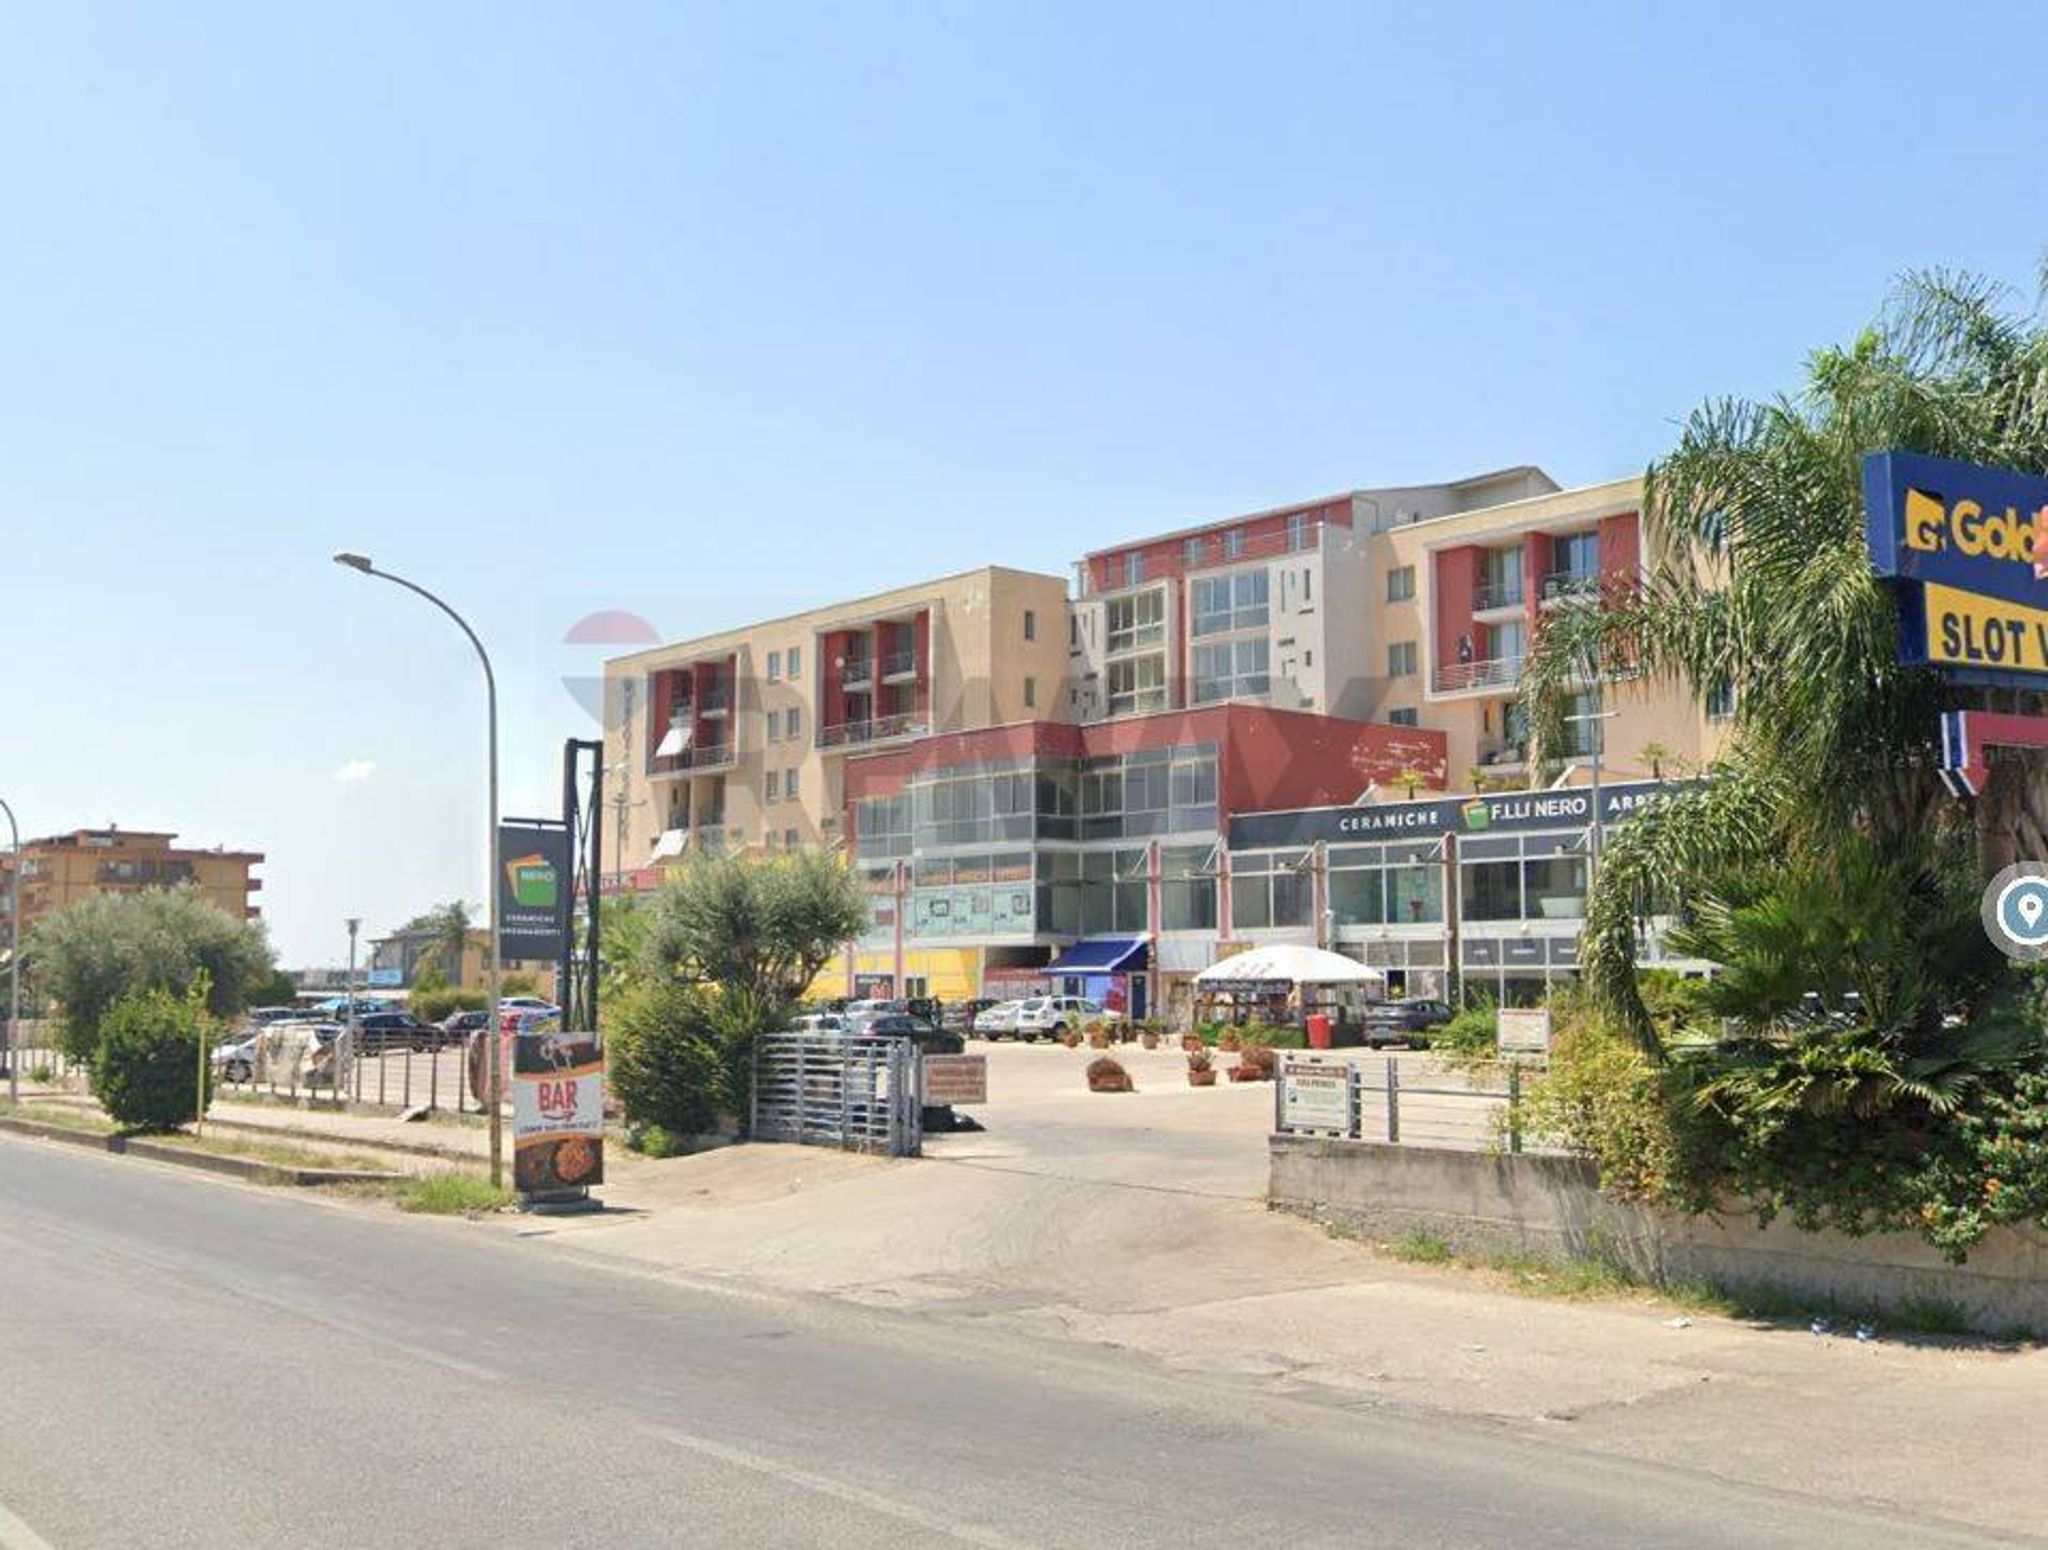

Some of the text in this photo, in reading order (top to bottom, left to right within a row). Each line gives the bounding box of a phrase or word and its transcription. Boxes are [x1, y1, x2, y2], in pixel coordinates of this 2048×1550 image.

[1942, 612, 2026, 664] SLOT
[1339, 810, 1439, 831] CERAMICHE
[1535, 797, 1586, 817] NERO
[538, 1080, 579, 1112] BAR
